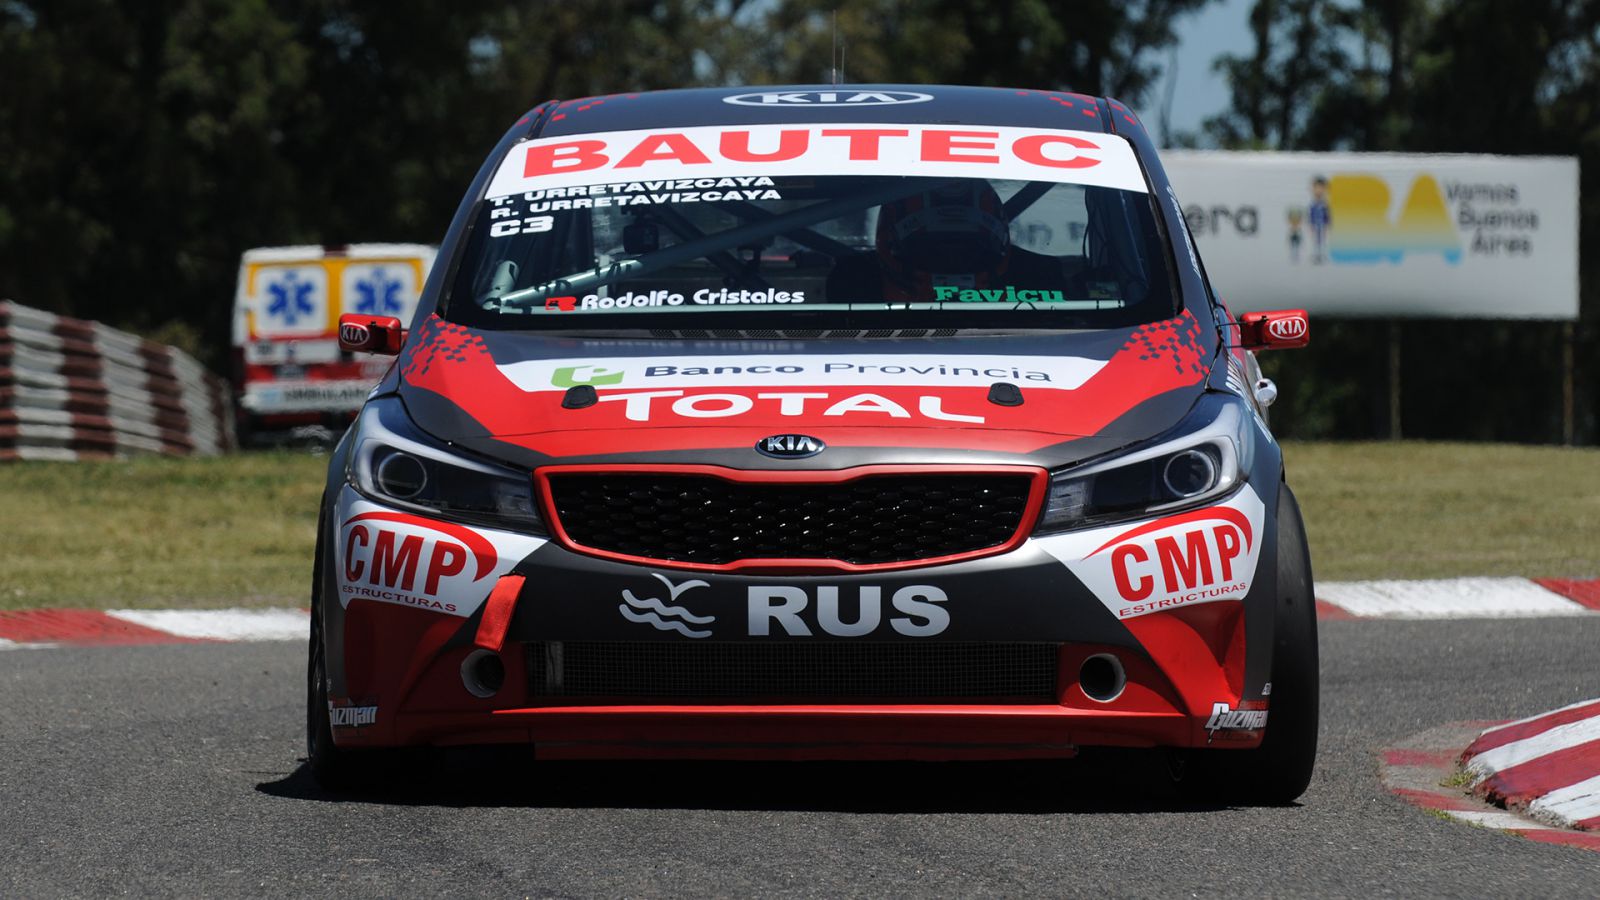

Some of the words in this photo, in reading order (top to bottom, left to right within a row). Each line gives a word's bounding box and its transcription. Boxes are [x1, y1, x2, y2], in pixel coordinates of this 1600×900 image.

[762, 92, 898, 103] KIA
[523, 129, 1102, 178] BAUTEC
[490, 196, 513, 207] T.
[524, 176, 775, 200] URRETAVIZCAYA
[490, 208, 518, 220] R.
[530, 189, 781, 213] URRETAVIZCAYA
[1445, 181, 1519, 204] Vamos
[490, 215, 554, 238] C3
[1184, 204, 1259, 237] era
[1458, 201, 1539, 231] Buenos
[1471, 229, 1533, 257] Aires
[581, 289, 684, 311] Rodolfo
[693, 288, 805, 306] Cristales
[934, 285, 1065, 302] Favicu
[342, 326, 363, 341] KIA
[1276, 319, 1302, 336] KIA
[645, 365, 804, 377] Banco
[824, 362, 1052, 382] Provincia
[598, 389, 985, 424] TOTAL
[767, 436, 813, 451] KIA
[344, 524, 467, 596] CMP
[1110, 524, 1241, 602] CMP
[342, 585, 457, 612] ESTRUCTURAS
[748, 584, 950, 637] RUS
[1119, 582, 1246, 617] ESTRUCTURAS
